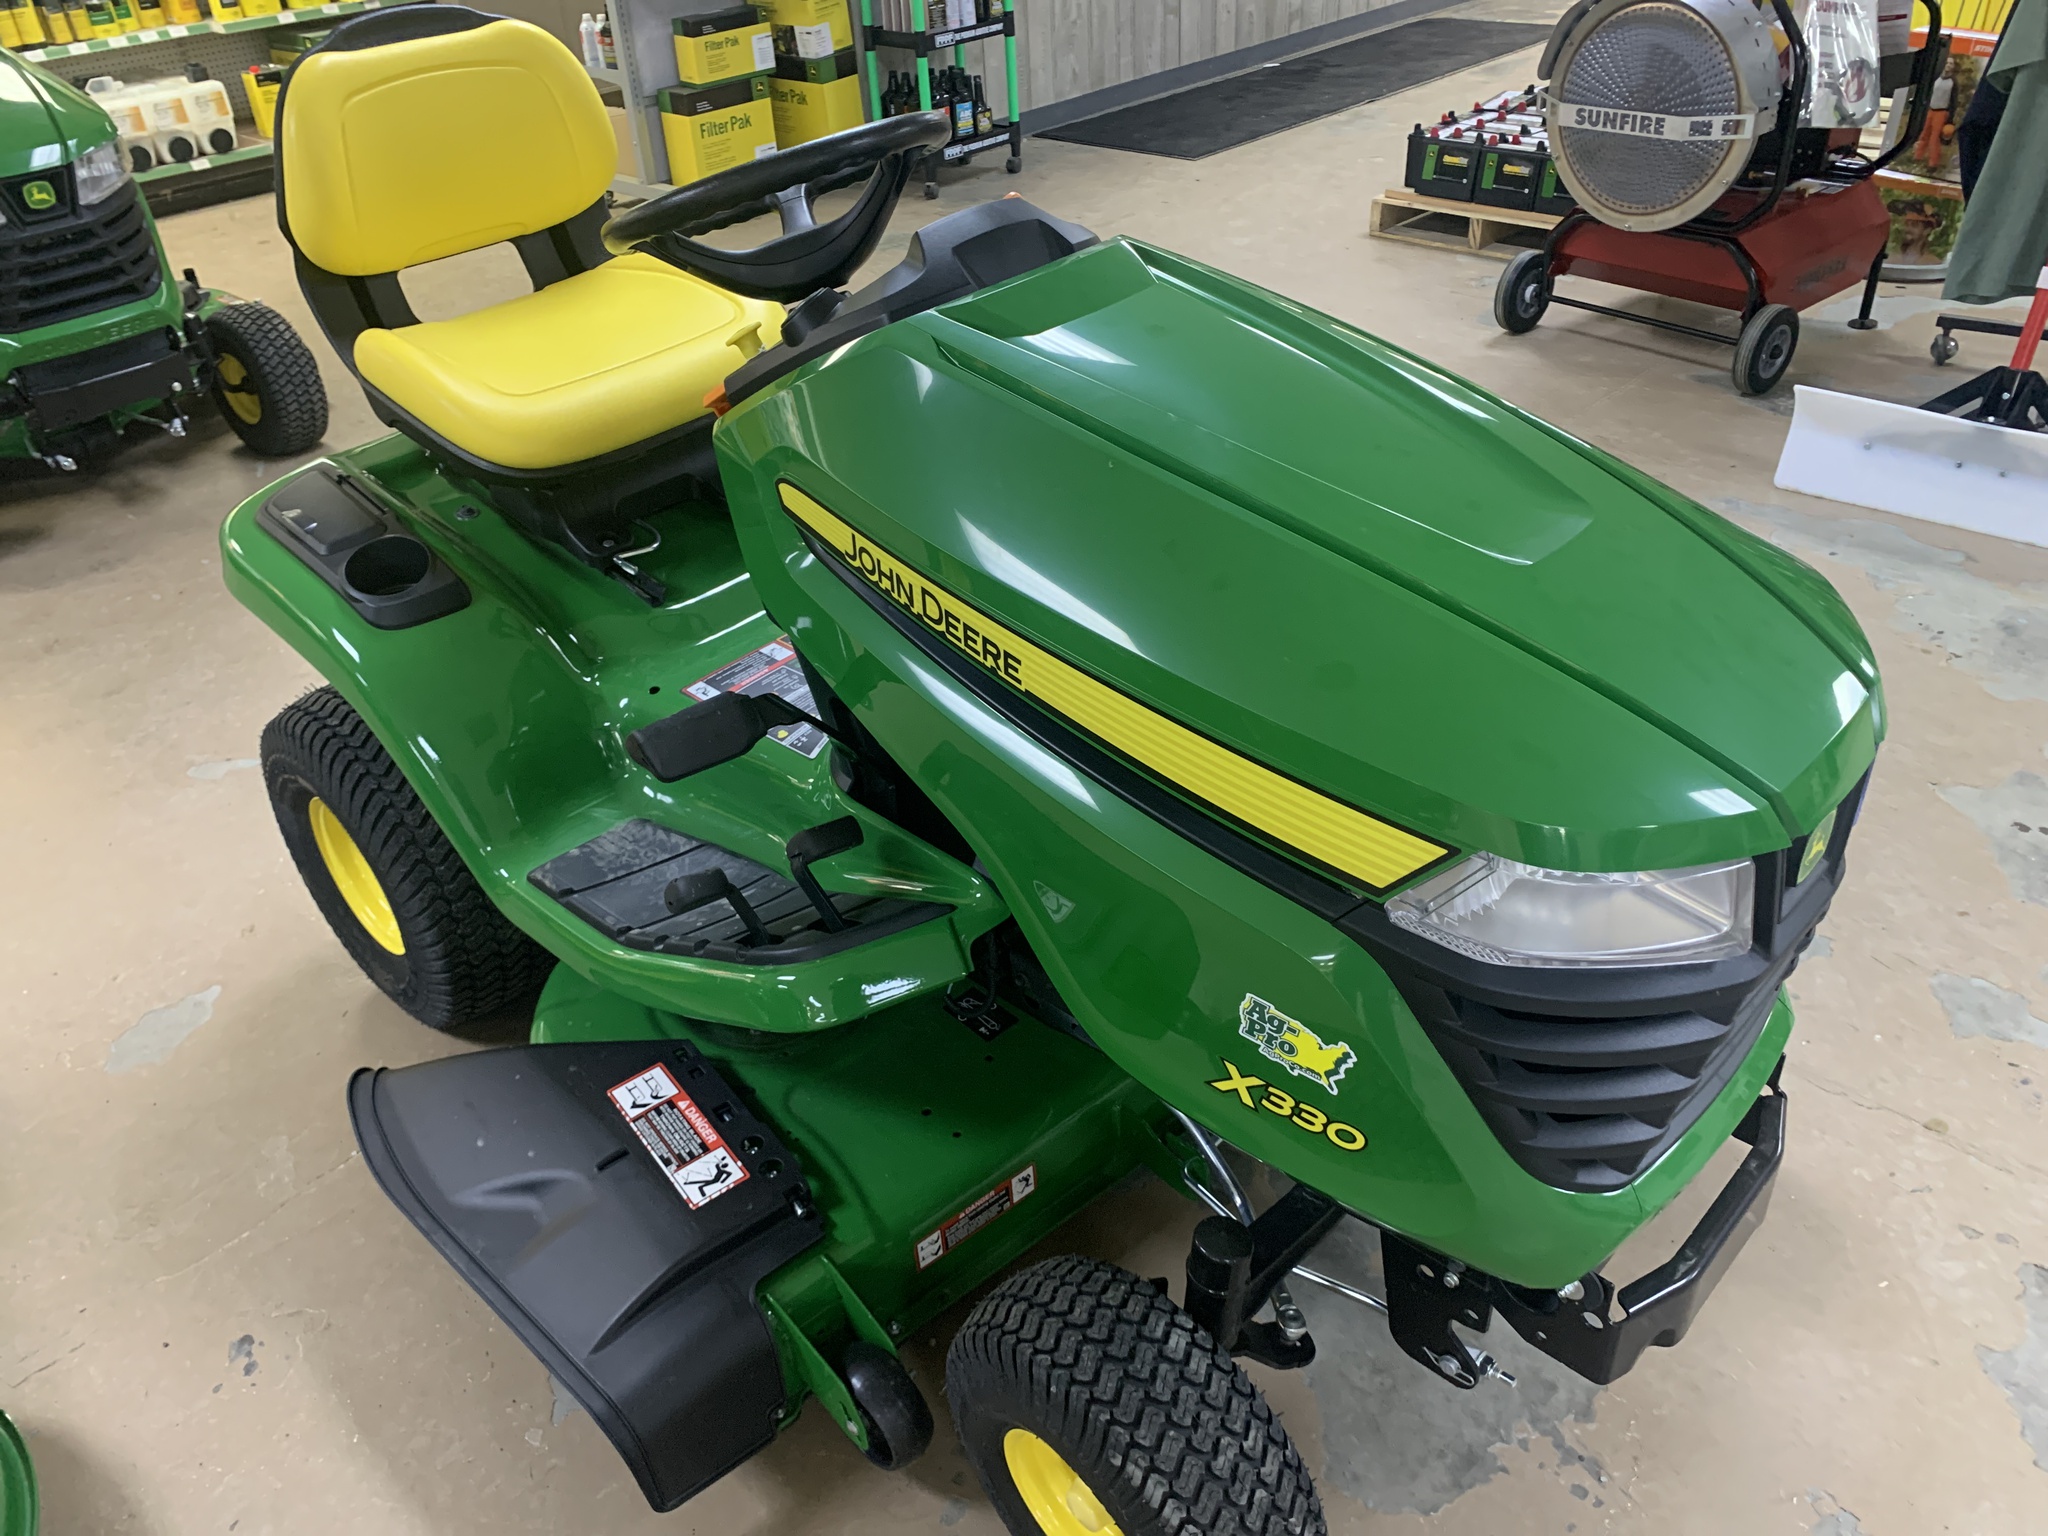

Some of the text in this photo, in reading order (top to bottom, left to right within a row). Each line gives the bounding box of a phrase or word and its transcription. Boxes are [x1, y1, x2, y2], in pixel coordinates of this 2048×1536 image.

[704, 35, 740, 52] Filter Pak
[789, 89, 808, 106] Pak
[699, 119, 729, 139] Filter
[730, 113, 752, 131] Pak
[1574, 107, 1666, 136] SUNFIRE
[845, 532, 1022, 686] JOHN DEERE
[1244, 999, 1300, 1036] Ag-
[1243, 1018, 1298, 1057] Pro
[1262, 1046, 1322, 1081] AgProCo.com
[1205, 1056, 1368, 1152] X330
[684, 1106, 718, 1144] DANGER
[965, 1190, 996, 1213] DANGER
